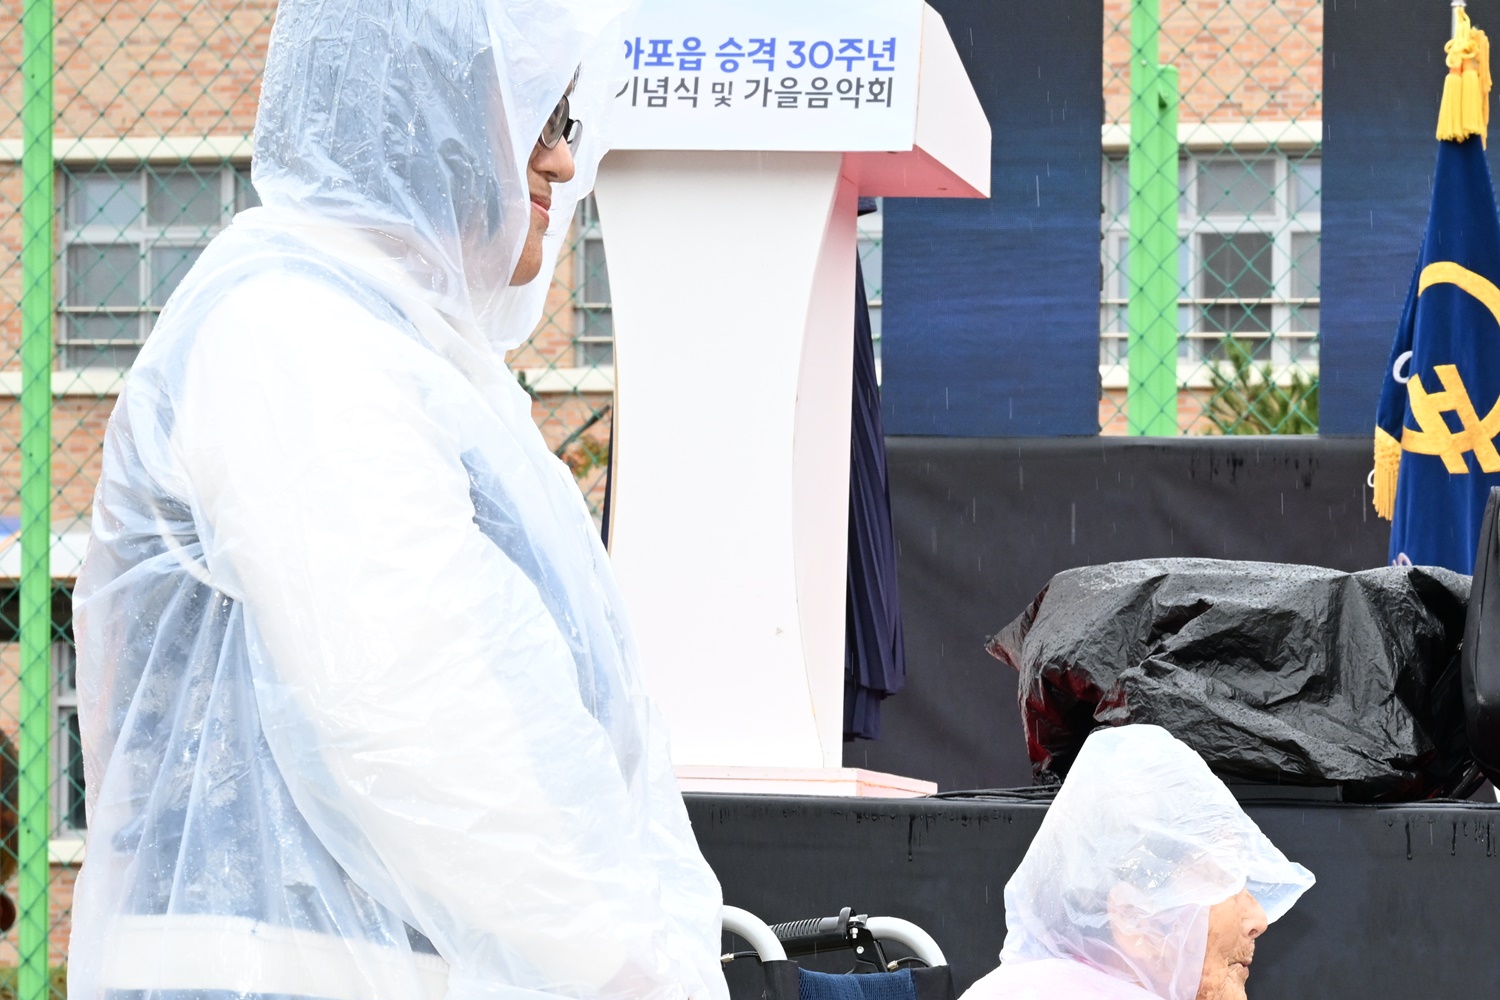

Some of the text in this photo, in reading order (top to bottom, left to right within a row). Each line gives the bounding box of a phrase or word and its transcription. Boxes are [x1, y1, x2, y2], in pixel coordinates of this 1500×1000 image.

[715, 37, 776, 73] 승격
[786, 37, 896, 72] 30주년
[711, 81, 733, 107] 및
[744, 77, 893, 109] 가을음악회
